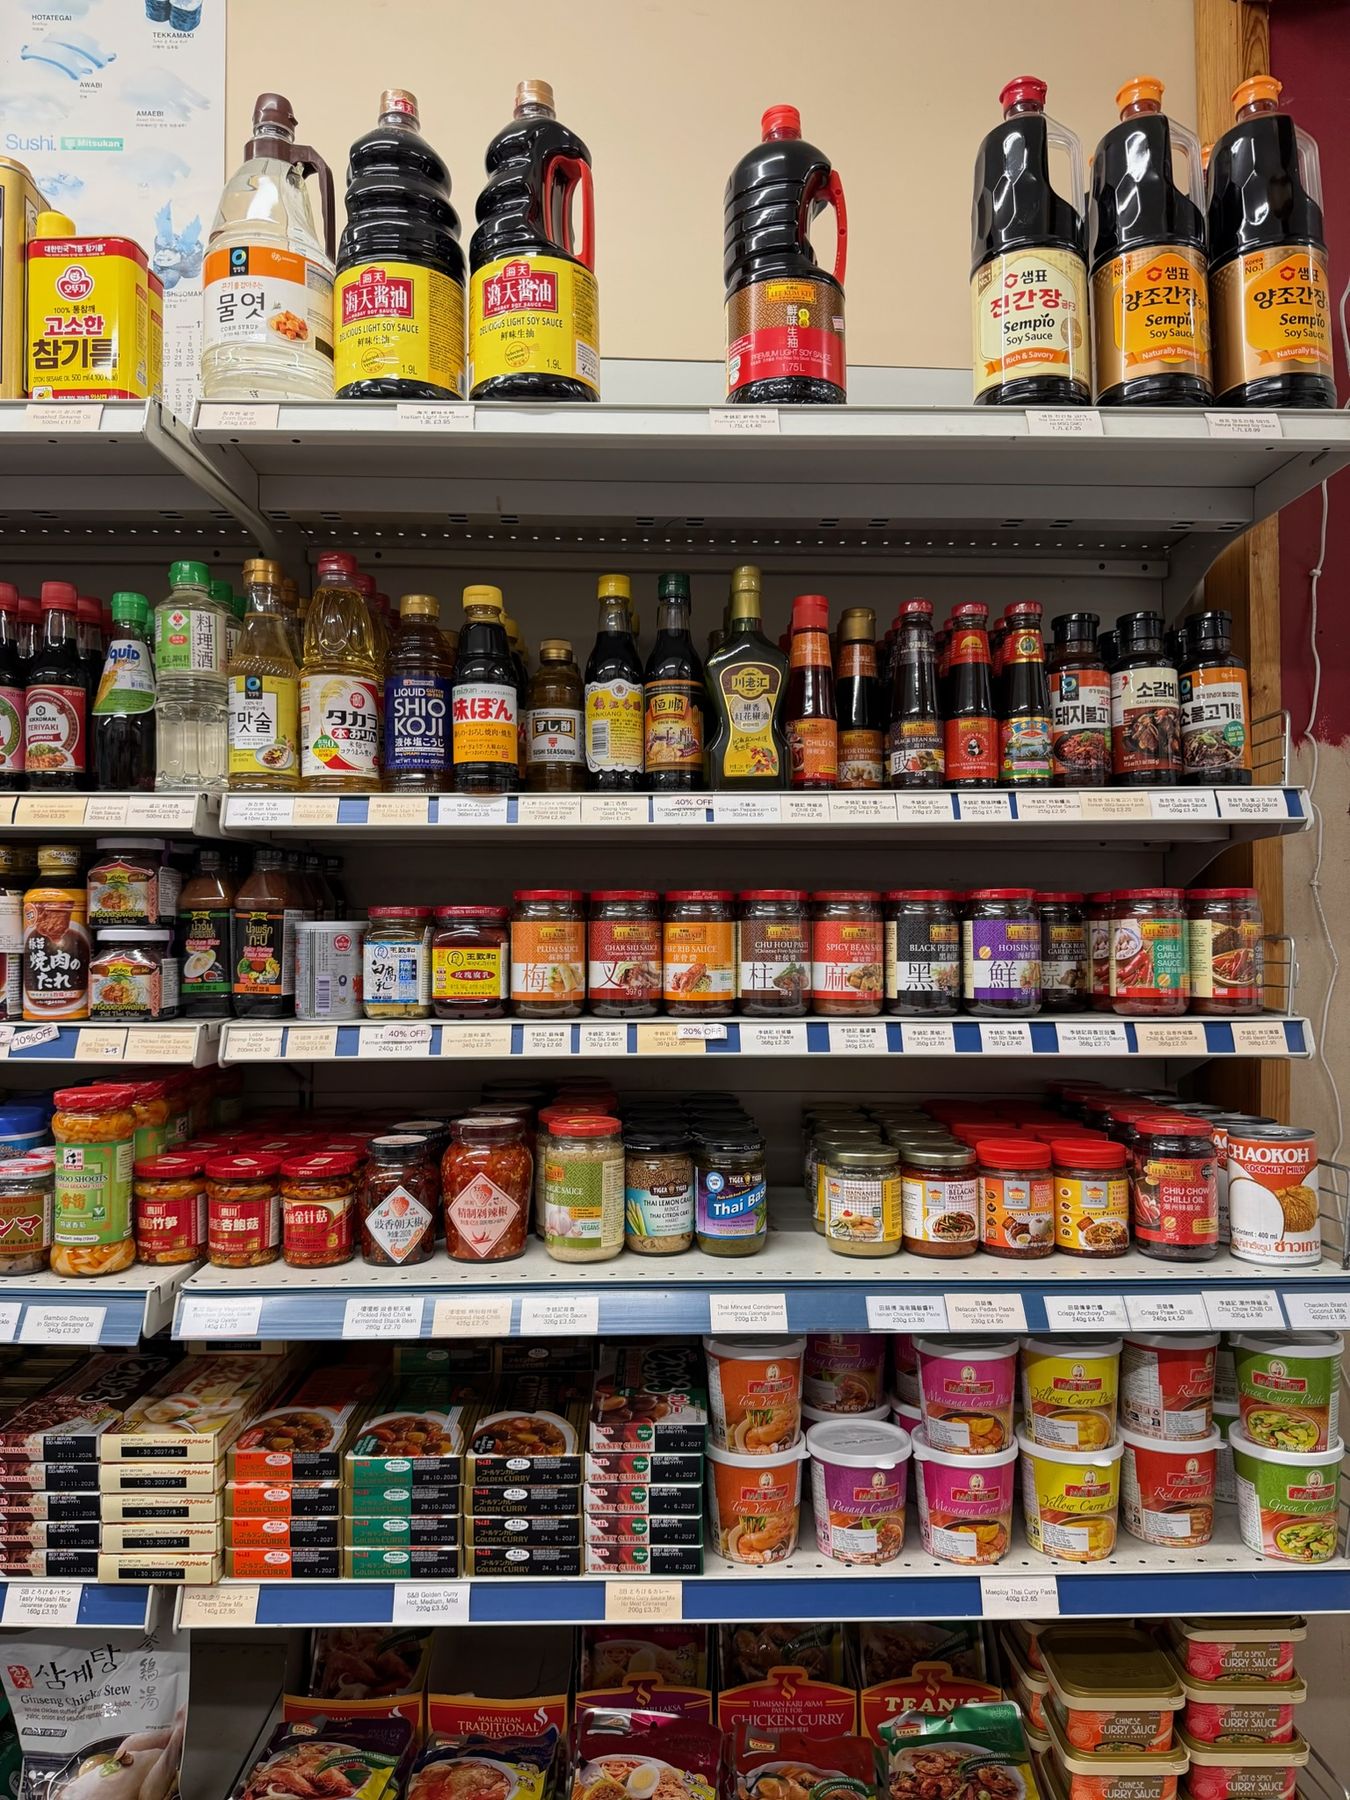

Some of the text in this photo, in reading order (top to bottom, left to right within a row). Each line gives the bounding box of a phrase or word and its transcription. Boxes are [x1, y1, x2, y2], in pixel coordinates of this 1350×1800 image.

[32, 14, 72, 22] HOTATEGAI
[153, 32, 194, 40] TEKKAMAKI
[1020, 269, 1047, 285] 샘표
[64, 284, 87, 294] 오뚜기
[345, 284, 408, 311] 海天酱油
[217, 291, 265, 323] 물엿
[991, 289, 1062, 319] 진간장
[54, 307, 71, 316] 100%
[45, 316, 104, 336] 고소한
[480, 316, 563, 336] DELICIOUS LIGHT SOY SAUCE
[1003, 313, 1055, 335] Sempio
[1007, 330, 1053, 346] Soy Sauce
[33, 338, 120, 370] 참기름
[780, 349, 797, 357] LIGHT
[1007, 353, 1022, 365] Rich
[1029, 351, 1054, 361] Savory
[546, 358, 561, 371] 1.9L
[782, 362, 806, 373] 1.75L
[196, 613, 213, 670] 料理酒
[733, 676, 768, 688] 川老汇
[394, 688, 426, 698] LIQUID
[394, 698, 446, 719] SHIO
[453, 698, 513, 722] 味ぽん
[653, 698, 684, 712] 恒順
[236, 711, 273, 734] 맛술
[326, 709, 378, 729] タカラ
[29, 723, 59, 732] TERIYAKI
[394, 717, 443, 738] KOJI
[536, 720, 572, 732] すし酢
[331, 727, 377, 744] 本みりん
[394, 737, 445, 749] 液体塩こうじ
[533, 748, 576, 757] SUSHI SEASONING
[536, 945, 579, 954] PLUM SAUCE
[604, 944, 622, 952] CHAR
[624, 944, 638, 952] SIU
[677, 945, 717, 953] RIB SAUCE
[755, 941, 791, 950] CHU HOU
[826, 943, 870, 952] SPICY BEAN
[910, 944, 936, 952] BLACK
[998, 944, 1029, 953] HOISIN
[1156, 944, 1179, 952] CHILLI
[29, 949, 81, 972] 焼肉の
[466, 953, 496, 961] 王致和
[1156, 952, 1182, 960] GARLIC
[1157, 960, 1181, 968] SAUCE
[454, 971, 493, 979] 玫瑰腐乳
[521, 962, 548, 993] 梅
[749, 962, 774, 991] 柱
[823, 962, 849, 991] 麻
[987, 960, 1017, 990] 鮮
[37, 973, 72, 991] たれ
[15, 1027, 54, 1046] 10%OFF
[388, 1029, 427, 1039] 40% OFF
[683, 1027, 722, 1036] 20% OFF
[1228, 1144, 1310, 1164] CHAOKOH
[1245, 1164, 1305, 1175] COCONUT MILK
[74, 1174, 108, 1184] SHOOTS
[948, 1183, 963, 1191] SPICY
[1163, 1187, 1209, 1196] CHIU CHOW
[948, 1188, 975, 1197] BELACAN
[643, 1199, 679, 1207] THAI LEMON
[1163, 1195, 1205, 1204] CHILLI OIL
[457, 1206, 508, 1220] 精制剁辣椒
[713, 1201, 743, 1217] Thai
[580, 1224, 601, 1232] VEGANS
[1058, 1309, 1076, 1317] Crispy
[1077, 1309, 1098, 1317] Anchovy
[351, 1317, 382, 1325] Fermented
[1072, 1315, 1087, 1323] 240g
[47, 1327, 80, 1335] 340g £3.30
[1032, 1387, 1099, 1405] Yellow Curry
[1266, 1389, 1296, 1405] Curry
[595, 1441, 652, 1450] TASTY CURRY
[476, 1475, 530, 1483] GOLDEN CURRY
[1268, 1498, 1298, 1513] Green
[407, 1591, 420, 1599] S&B
[443, 1590, 459, 1599] Curry
[985, 1588, 1009, 1597] Maeploy
[1022, 1588, 1039, 1597] Curry
[18, 1595, 71, 1604] Tasty Hayashi Rice
[406, 1597, 459, 1606] Hot, Medium, Mild
[1005, 1594, 1038, 1603] 400g £2.65
[26, 1608, 59, 1616] 160g £3.10
[416, 1604, 449, 1613] 220g £3.50
[628, 1606, 642, 1614] 200g
[1231, 1650, 1244, 1658] HOT
[1251, 1650, 1266, 1658] SPICY
[35, 1643, 121, 1690] 삼계탕
[1220, 1657, 1277, 1669] CURRY SAUCE
[20, 1692, 63, 1708] Ginseng
[104, 1684, 131, 1699] Stew
[752, 1700, 823, 1708] TUMISAN KARI AYAM
[478, 1716, 521, 1724] MALAYSIAN
[731, 1713, 844, 1729] CHICKEN CURRY
[1114, 1717, 1140, 1726] CHINESE
[457, 1720, 540, 1732] TRADITIONAL
